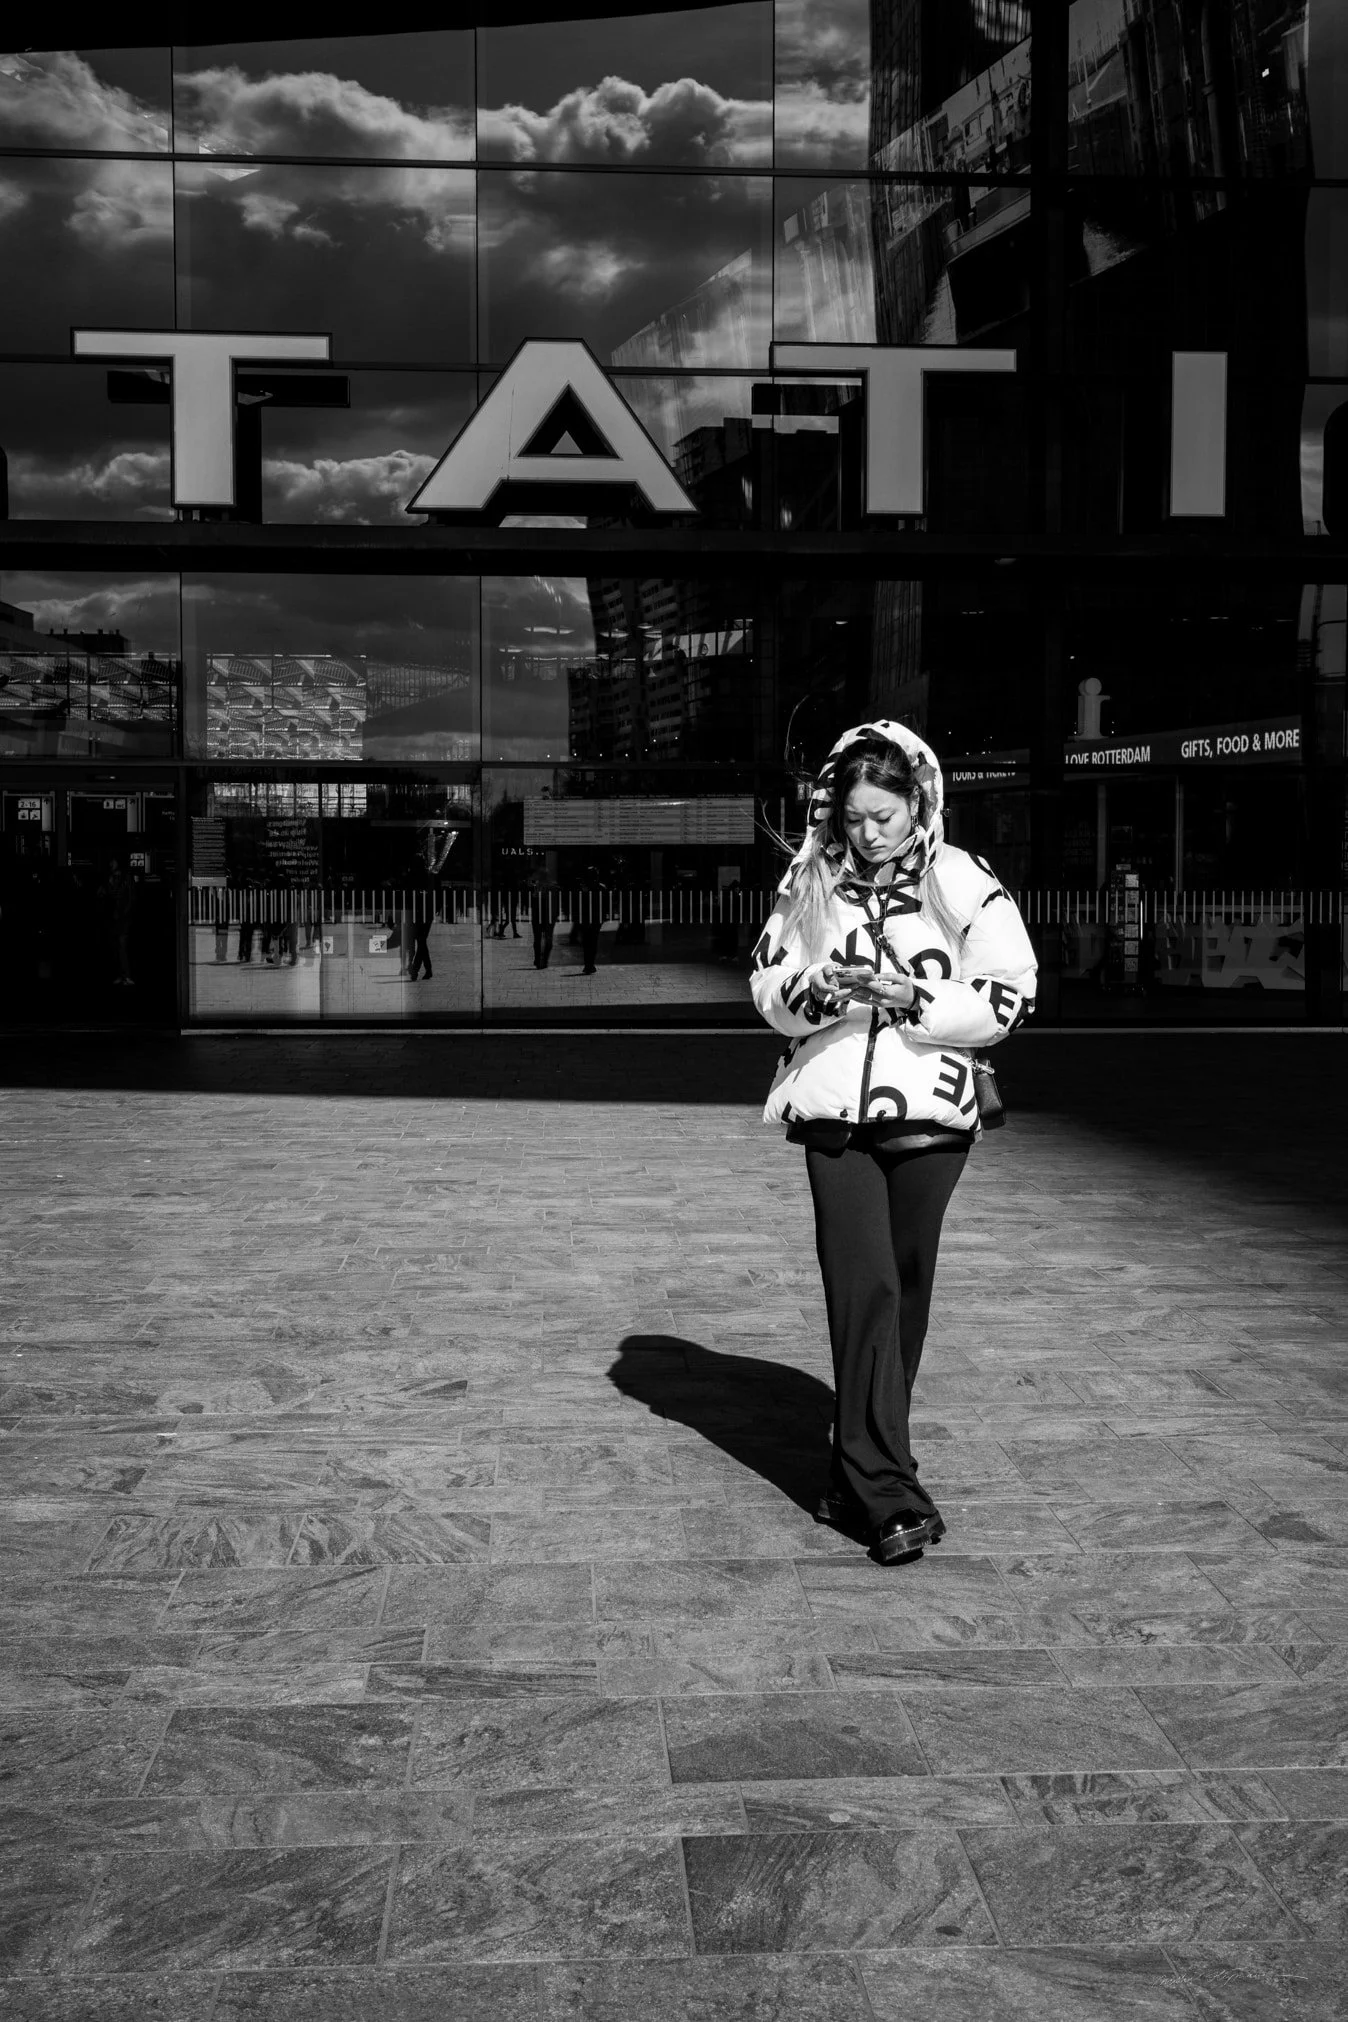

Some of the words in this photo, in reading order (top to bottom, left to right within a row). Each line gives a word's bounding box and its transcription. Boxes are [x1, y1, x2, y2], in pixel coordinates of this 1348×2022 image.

[1091, 745, 1151, 765] ROTTERDAM
[1180, 739, 1213, 758] GIFTS,
[1216, 735, 1250, 755] FOOD
[1252, 733, 1262, 751] &
[1264, 729, 1301, 750] MORE
